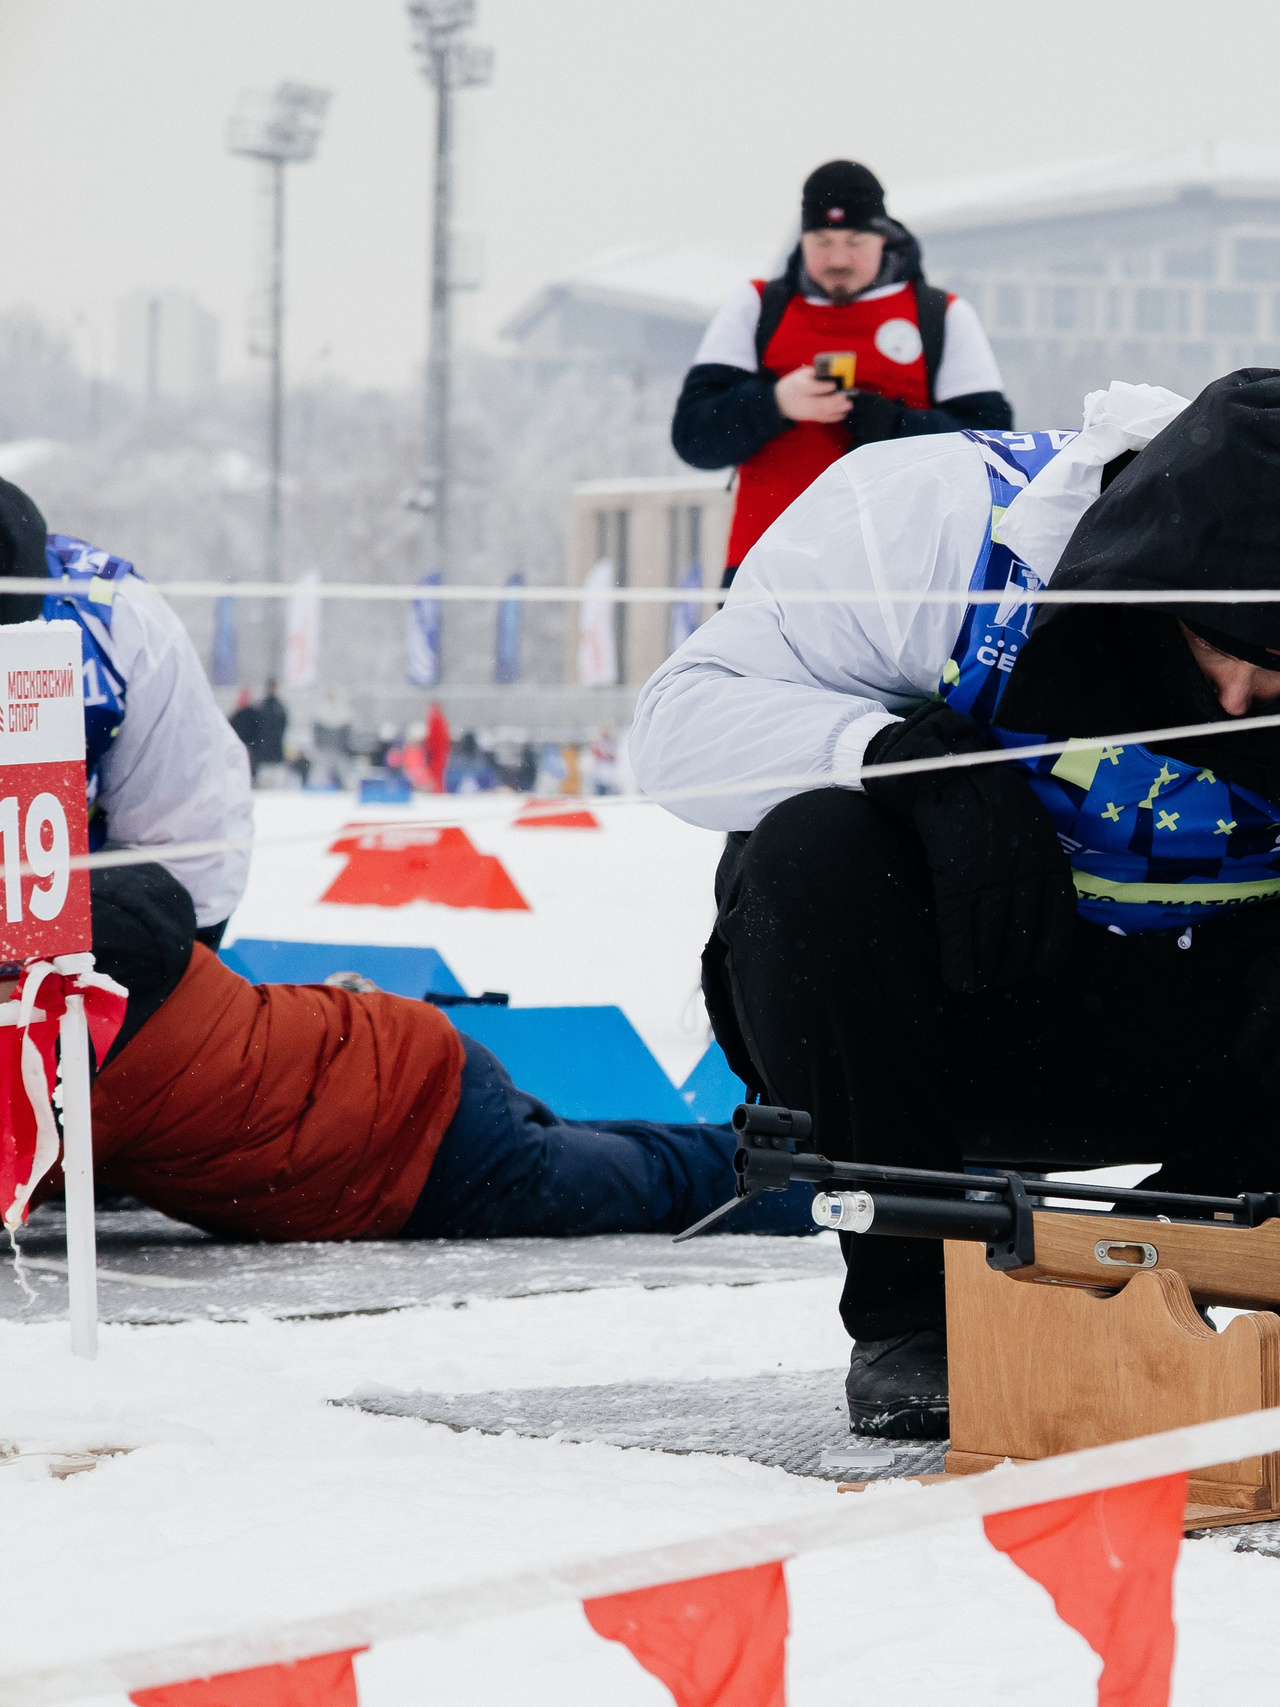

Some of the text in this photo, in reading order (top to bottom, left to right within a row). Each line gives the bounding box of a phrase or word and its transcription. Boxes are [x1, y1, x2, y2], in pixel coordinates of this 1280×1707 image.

[8, 662, 74, 699] МОСКОВСКИЙ
[9, 702, 39, 732] СПОРТ
[0, 792, 70, 923] 19
